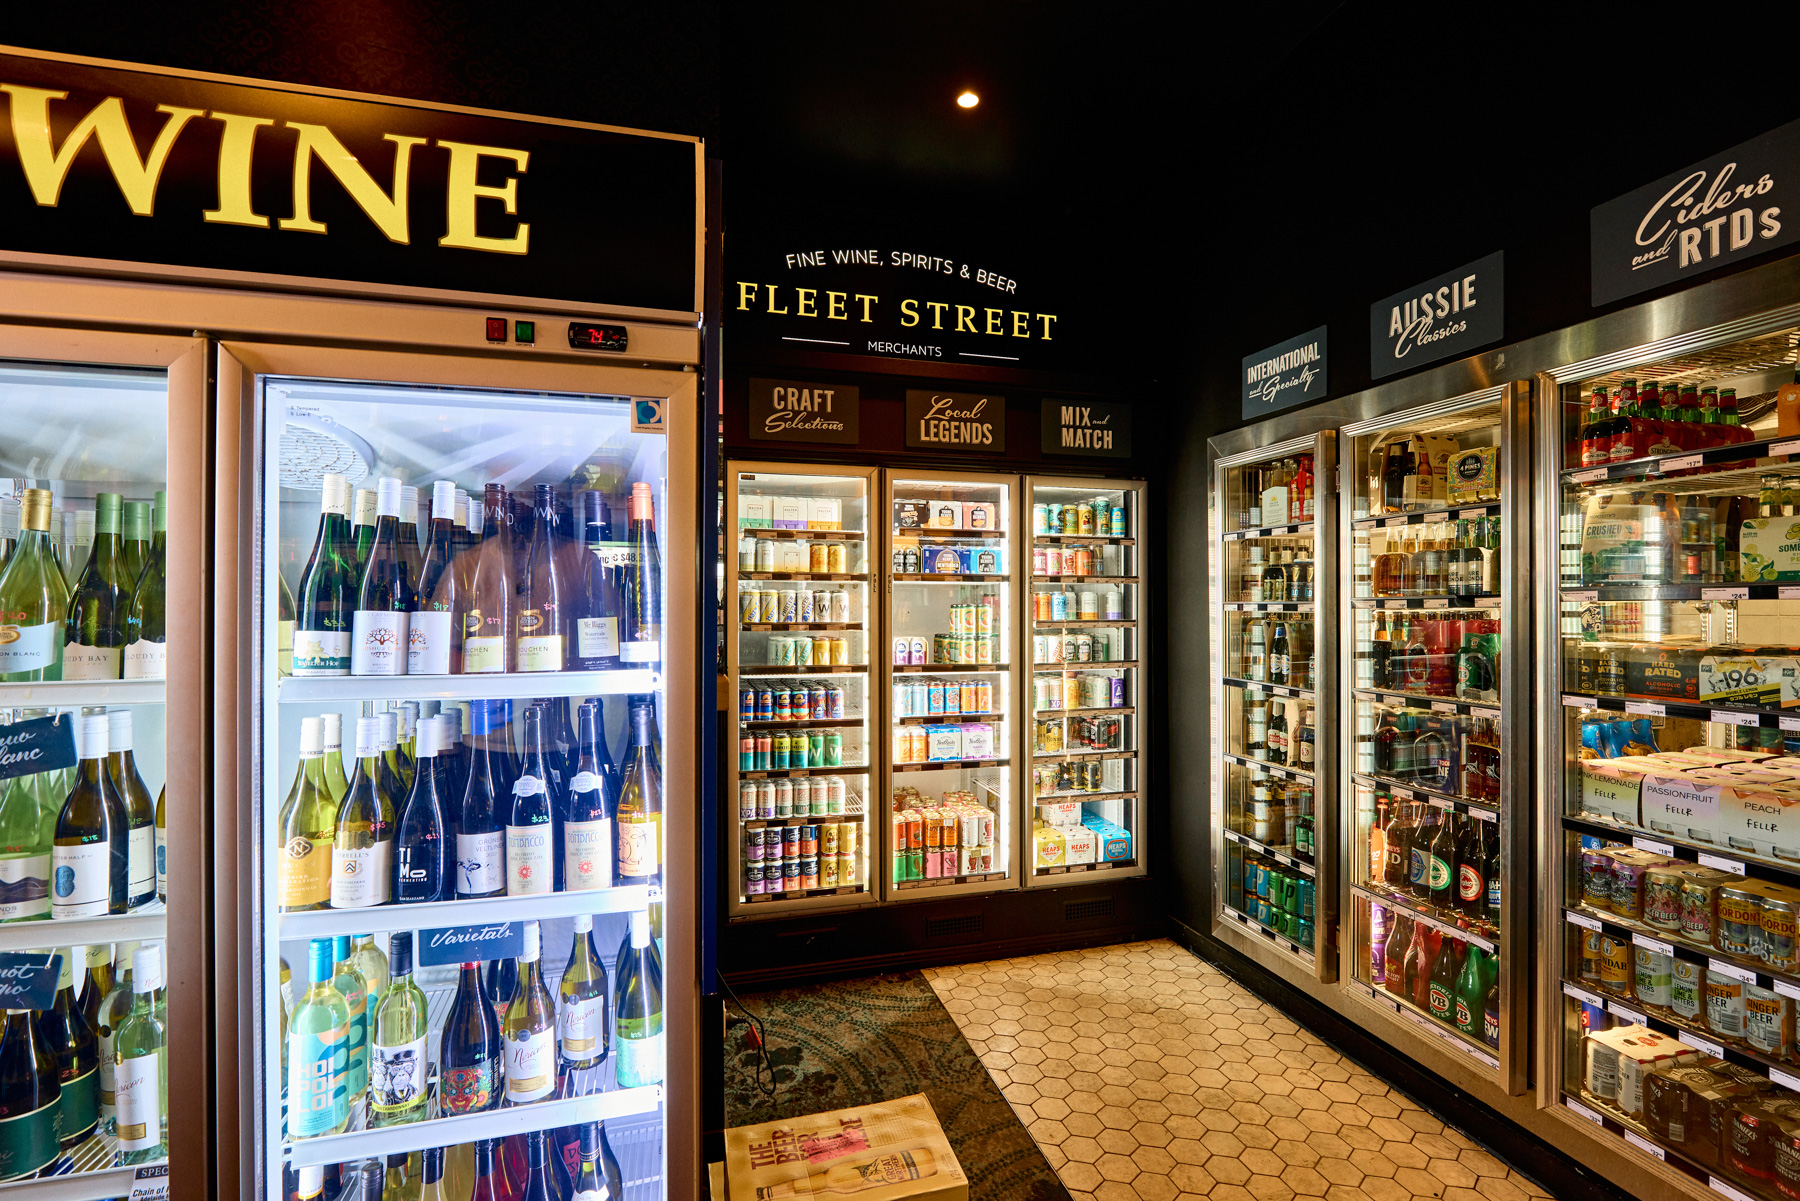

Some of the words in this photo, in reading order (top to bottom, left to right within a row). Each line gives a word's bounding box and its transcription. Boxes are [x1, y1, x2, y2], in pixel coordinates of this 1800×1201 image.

[0, 83, 530, 255] WINE
[1635, 162, 1773, 246] Ciders
[1632, 229, 1678, 265] and
[786, 251, 826, 269] FINE
[832, 250, 884, 266] WINE,
[891, 251, 953, 274] SPIRITS
[960, 264, 970, 279] &
[976, 269, 1017, 294] BEER
[737, 281, 878, 323] FLEET
[901, 299, 1057, 340] STREET
[1389, 274, 1476, 338] AUSSIE
[868, 341, 942, 357] MERCHANTS
[1394, 317, 1467, 359] Classics
[1247, 342, 1320, 384] INTERNATIONAL
[1262, 365, 1320, 403] Specialty
[773, 386, 835, 413] CRAFT
[924, 395, 988, 420] Local
[764, 411, 844, 433] Selections
[1061, 405, 1091, 427] MIX
[1092, 414, 1110, 425] and
[920, 420, 993, 445] LEGENDS
[1061, 427, 1113, 450] MATCH
[1586, 523, 1622, 536] CRUSHED
[1644, 668, 1681, 679] RATED
[1594, 774, 1640, 791] LEMONADE
[1594, 788, 1617, 801] FELLR
[1647, 785, 1714, 804] PASSIONFRUIT
[1665, 804, 1693, 817] FELLR
[1744, 801, 1781, 815] PEACH
[1746, 818, 1779, 832] FELLR
[1042, 845, 1060, 853] HEAPS
[431, 922, 514, 948] Varietals
[1686, 921, 1704, 930] BEER
[1761, 916, 1796, 934] GORDO
[1675, 982, 1693, 993] LEMON
[1431, 994, 1446, 1008] VB
[1707, 995, 1727, 1009] BEER
[1750, 1010, 1773, 1025] BEER
[297, 1056, 334, 1079] HOI
[297, 1091, 333, 1114] LOI
[749, 1141, 776, 1171] THE
[772, 1127, 801, 1166] BEER
[132, 1187, 155, 1198] Chain
[156, 1186, 165, 1195] of
